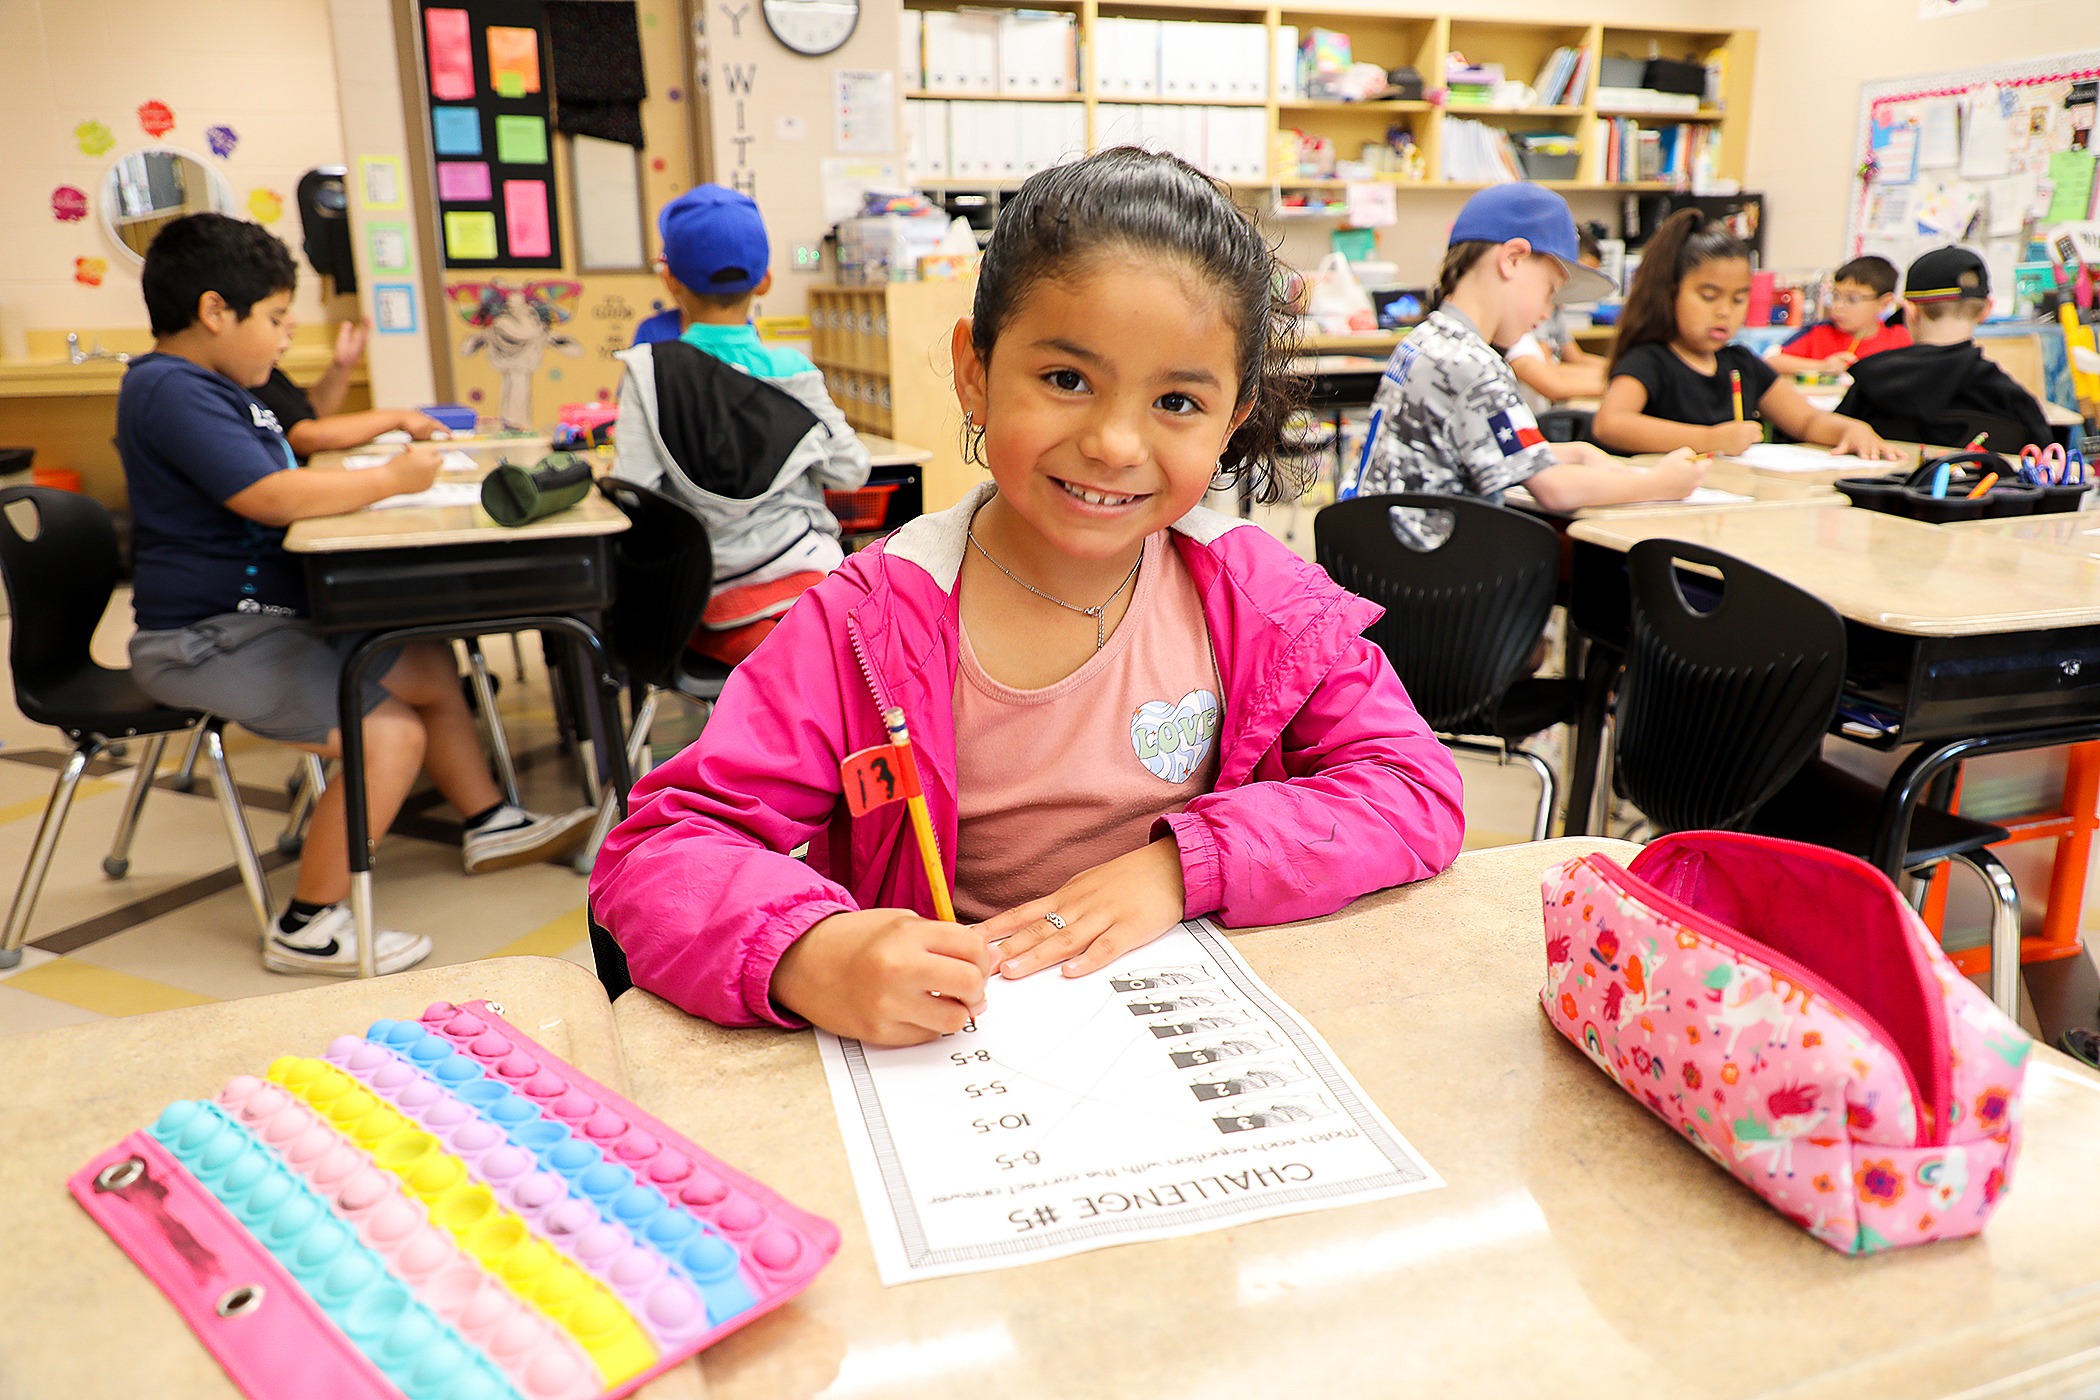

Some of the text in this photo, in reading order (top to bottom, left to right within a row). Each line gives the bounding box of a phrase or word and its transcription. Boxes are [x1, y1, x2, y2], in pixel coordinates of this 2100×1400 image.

[722, 62, 757, 197] WITH
[1135, 707, 1218, 760] LOVE
[857, 756, 896, 809] 13
[950, 1049, 991, 1067] 8-5
[1191, 1050, 1209, 1065] 5
[964, 1080, 1008, 1099] 5-5
[1213, 1082, 1231, 1097] 2
[972, 1113, 1031, 1134] 10-5
[1235, 1115, 1255, 1131] 3
[927, 1128, 1359, 1204] Match each equation with the correct answer
[995, 1150, 1041, 1171] 6-5
[1008, 1162, 1314, 1232] CHALLENGE #5
